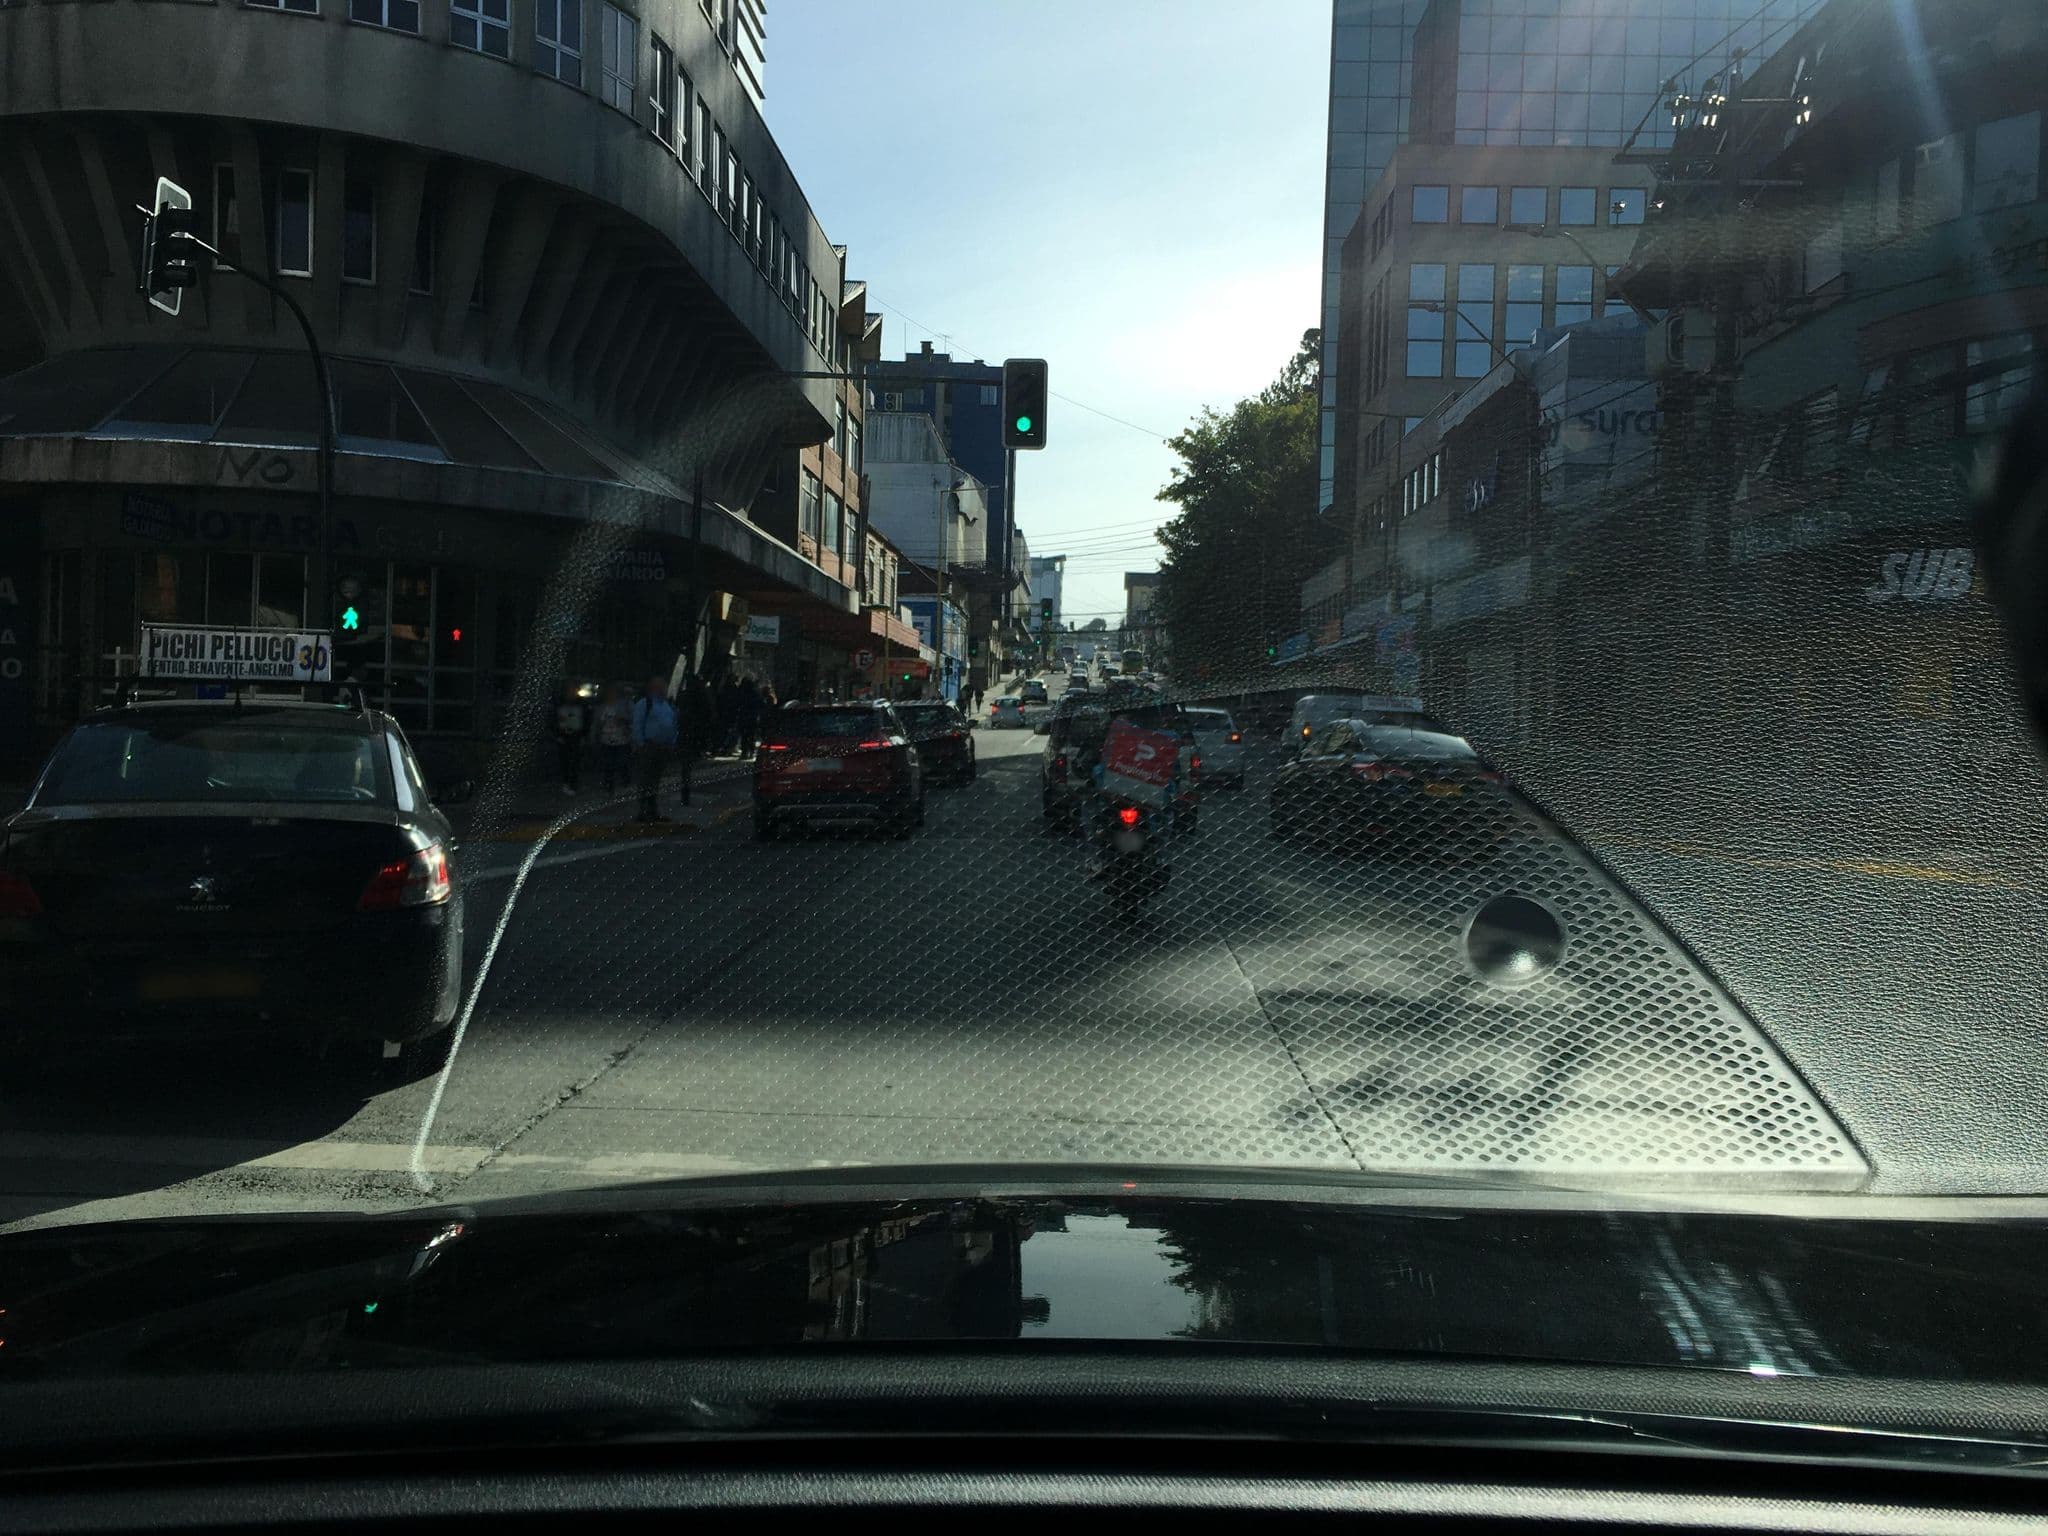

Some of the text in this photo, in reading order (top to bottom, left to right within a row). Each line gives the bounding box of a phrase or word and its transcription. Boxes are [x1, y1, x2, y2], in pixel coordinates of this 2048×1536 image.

[1578, 408, 1658, 434] sura
[177, 509, 360, 549] NOTARA
[1865, 549, 1977, 601] SUB
[150, 632, 328, 671] PICHI PELLUCO 30
